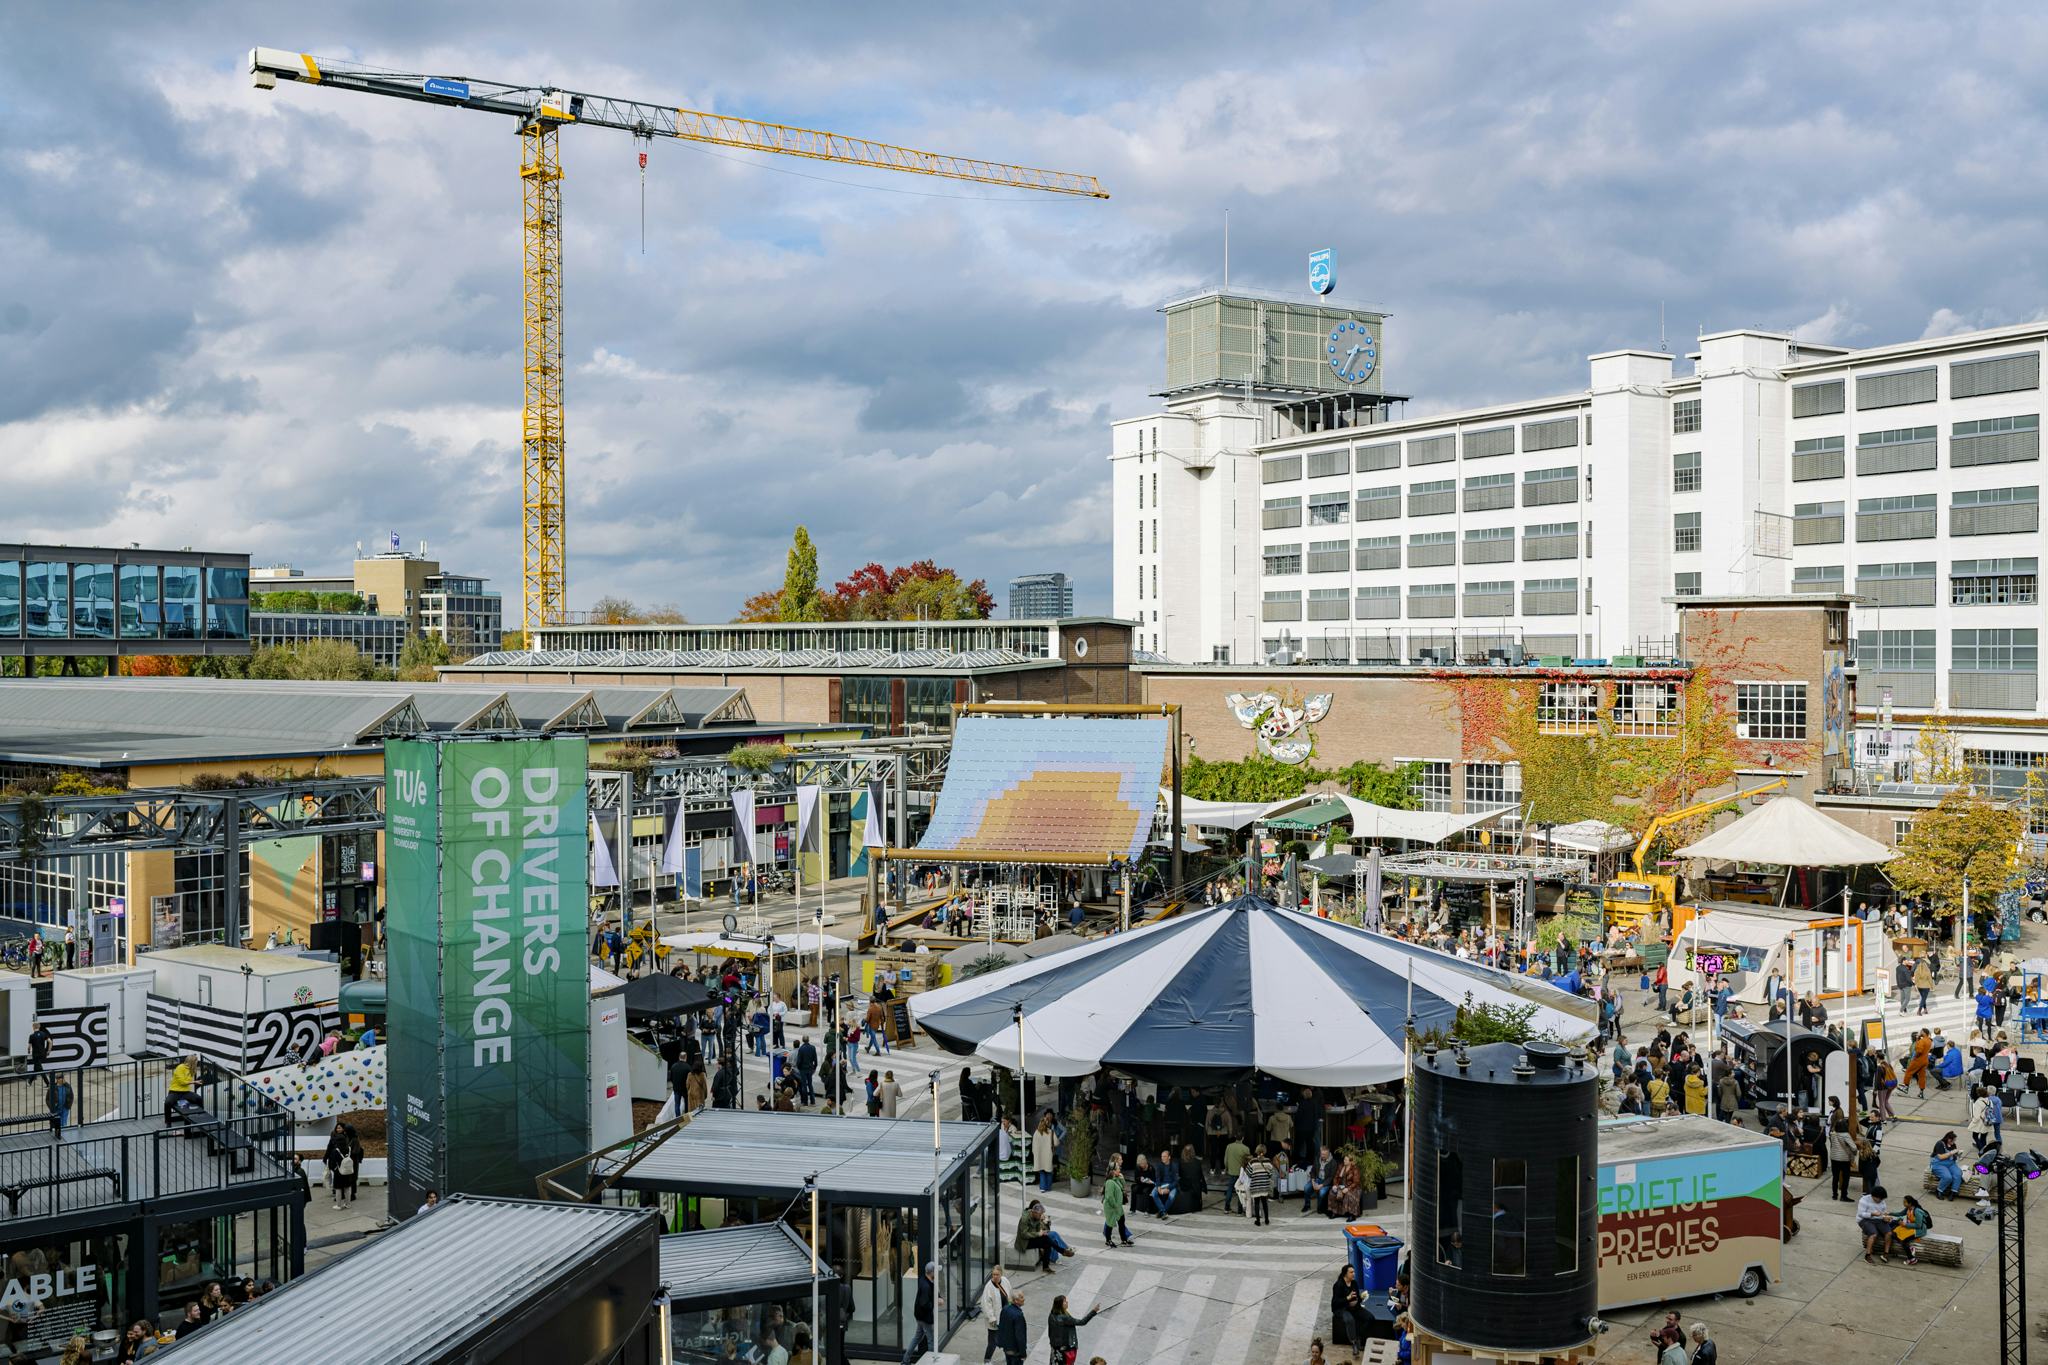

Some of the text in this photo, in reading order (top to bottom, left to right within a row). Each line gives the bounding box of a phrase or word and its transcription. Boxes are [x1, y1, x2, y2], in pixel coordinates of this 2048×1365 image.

[393, 768, 427, 808] TU/e
[522, 767, 560, 976] DRIVERS
[1446, 857, 1489, 871] PIZZA
[470, 767, 512, 1068] OF CHANGE
[407, 1093, 424, 1109] DRIVERS
[413, 1107, 430, 1122] CHANGE
[1598, 1173, 1718, 1223] FRIETJE
[1598, 1216, 1720, 1268] PRECIES
[1626, 1273, 1638, 1281] EEN
[1672, 1264, 1692, 1274] FRIETJE
